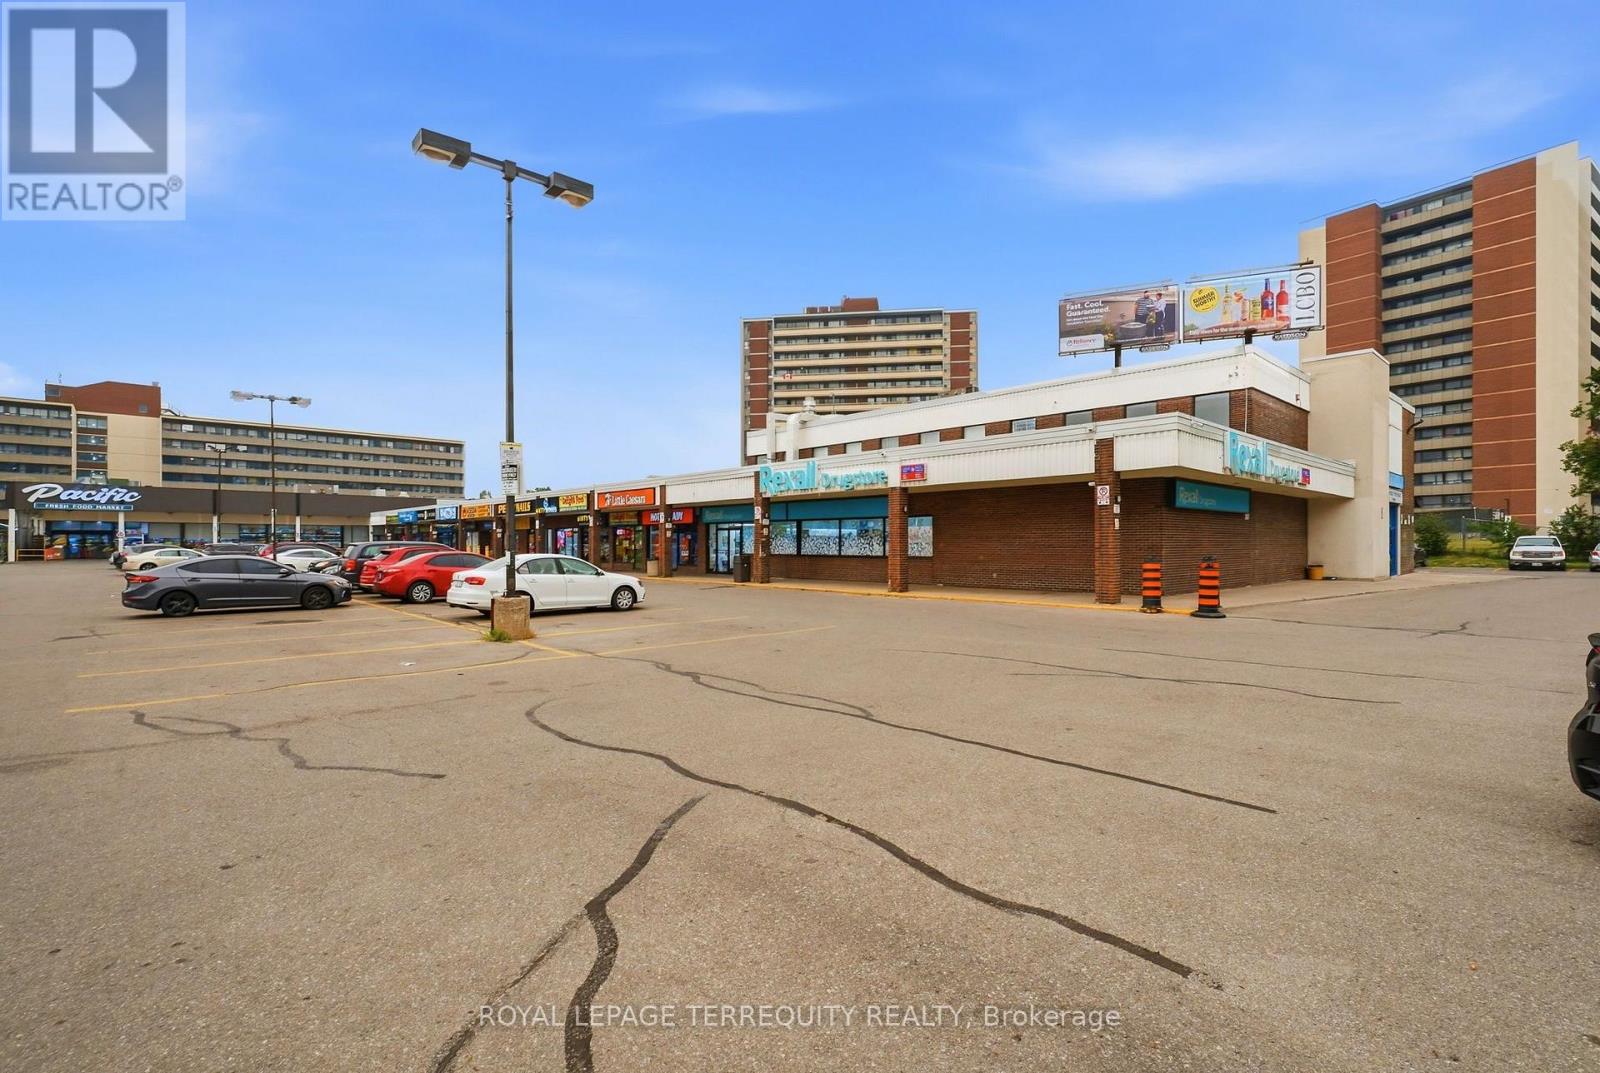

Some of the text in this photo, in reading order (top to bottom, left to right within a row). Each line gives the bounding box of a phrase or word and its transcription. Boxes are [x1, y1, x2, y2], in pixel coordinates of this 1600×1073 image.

[1193, 291, 1215, 304] SUMMER
[1194, 296, 1216, 309] WORTHY
[1295, 272, 1316, 320] LCBO
[1066, 300, 1104, 311] Fast. Cool.
[1066, 307, 1111, 317] Guaranteed.
[760, 460, 817, 495] Rexall
[820, 469, 888, 490] Drugstore
[22, 484, 142, 503] Pacific
